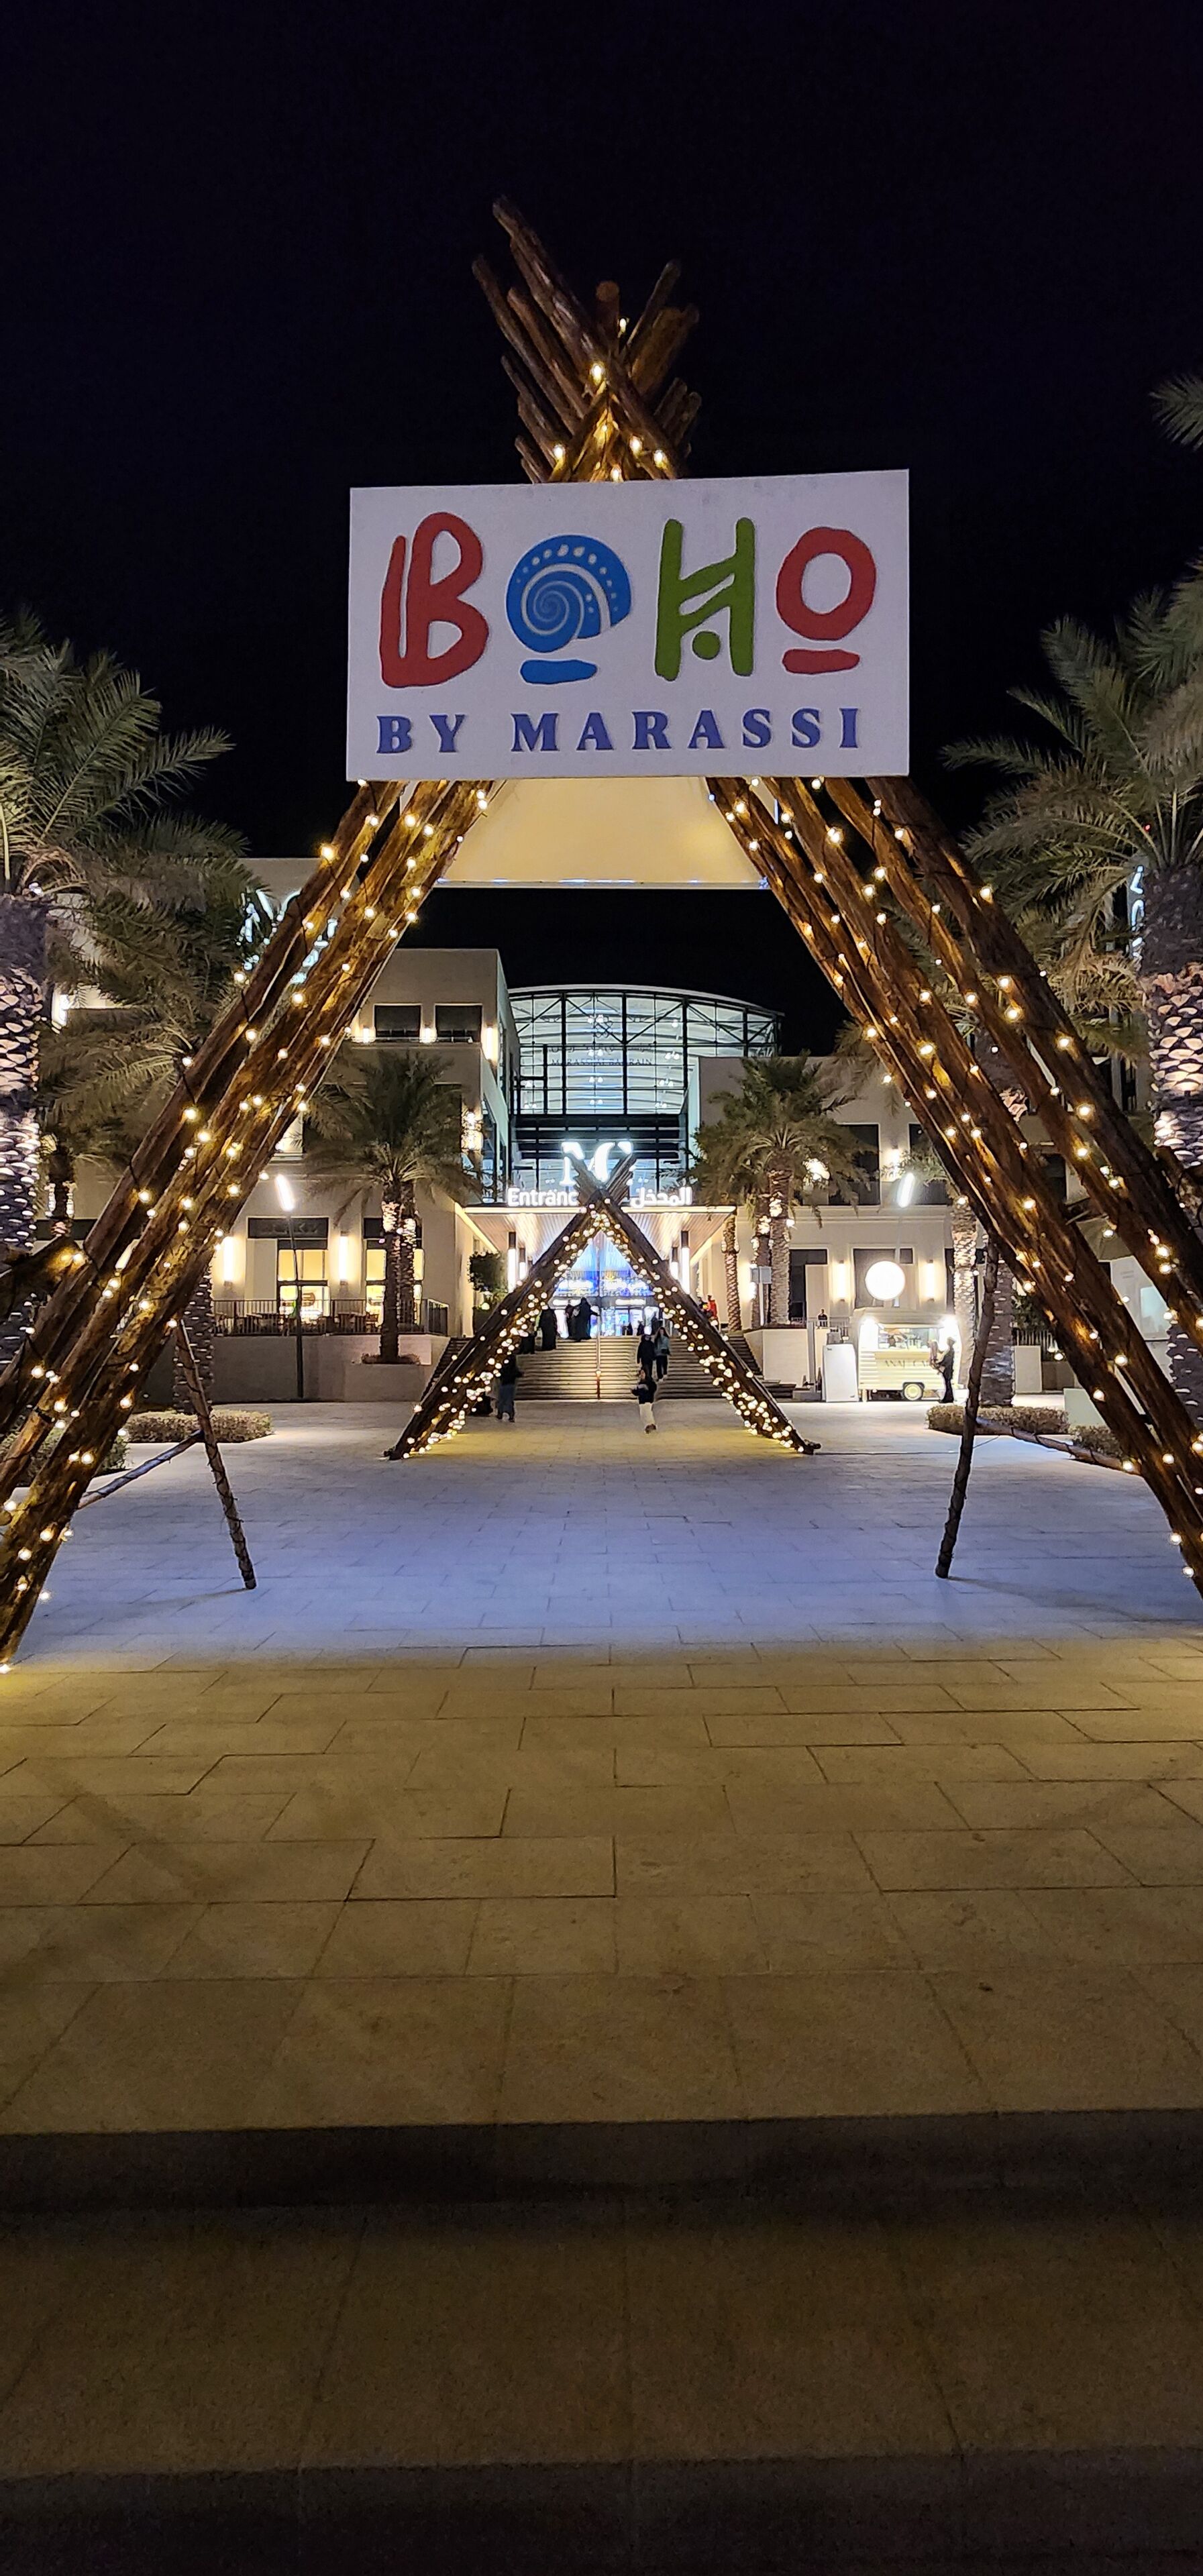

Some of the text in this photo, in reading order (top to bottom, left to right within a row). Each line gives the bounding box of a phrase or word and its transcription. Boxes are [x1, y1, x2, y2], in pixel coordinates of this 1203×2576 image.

[380, 511, 877, 688] BOHO
[376, 708, 860, 754] BY MARASSI
[507, 1187, 580, 1207] Entranc
[629, 1185, 693, 1209] المدخل
